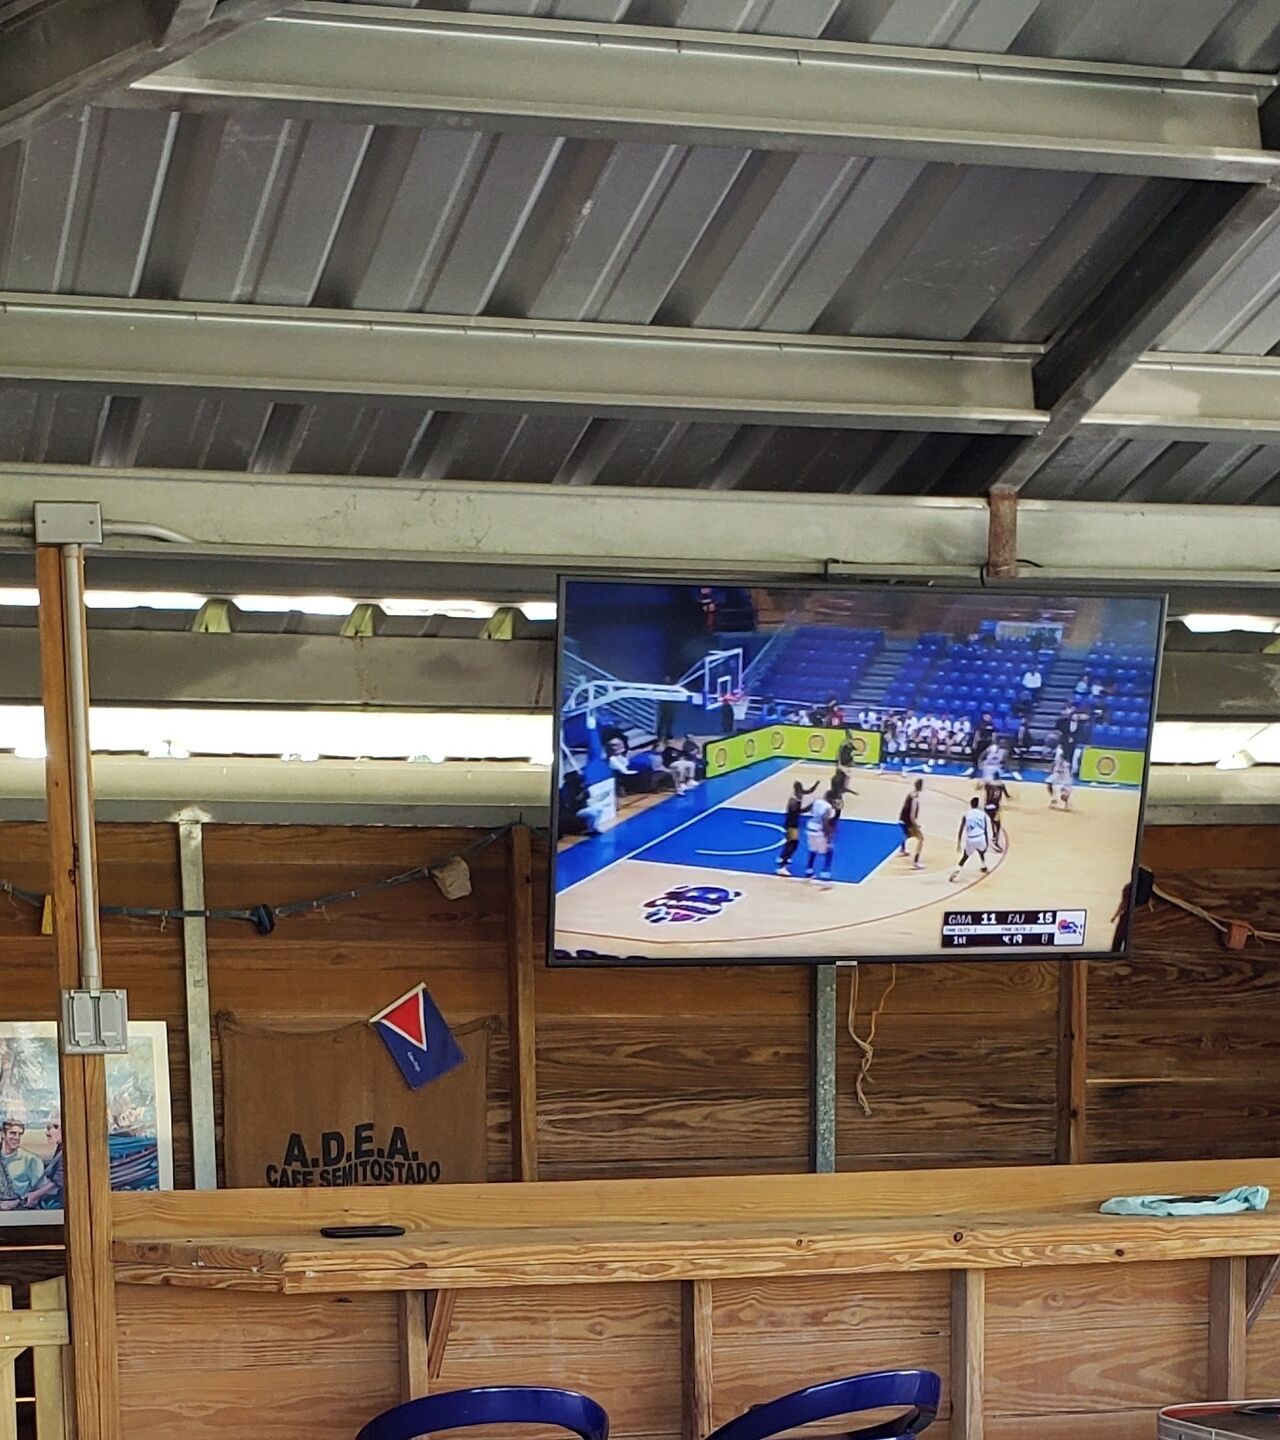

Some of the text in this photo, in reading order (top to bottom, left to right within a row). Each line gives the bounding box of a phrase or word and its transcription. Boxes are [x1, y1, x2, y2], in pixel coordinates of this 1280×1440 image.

[948, 912, 1053, 925] GMA 11 FAJ 15
[266, 1159, 441, 1188] CAFE SEMITOSTADO
